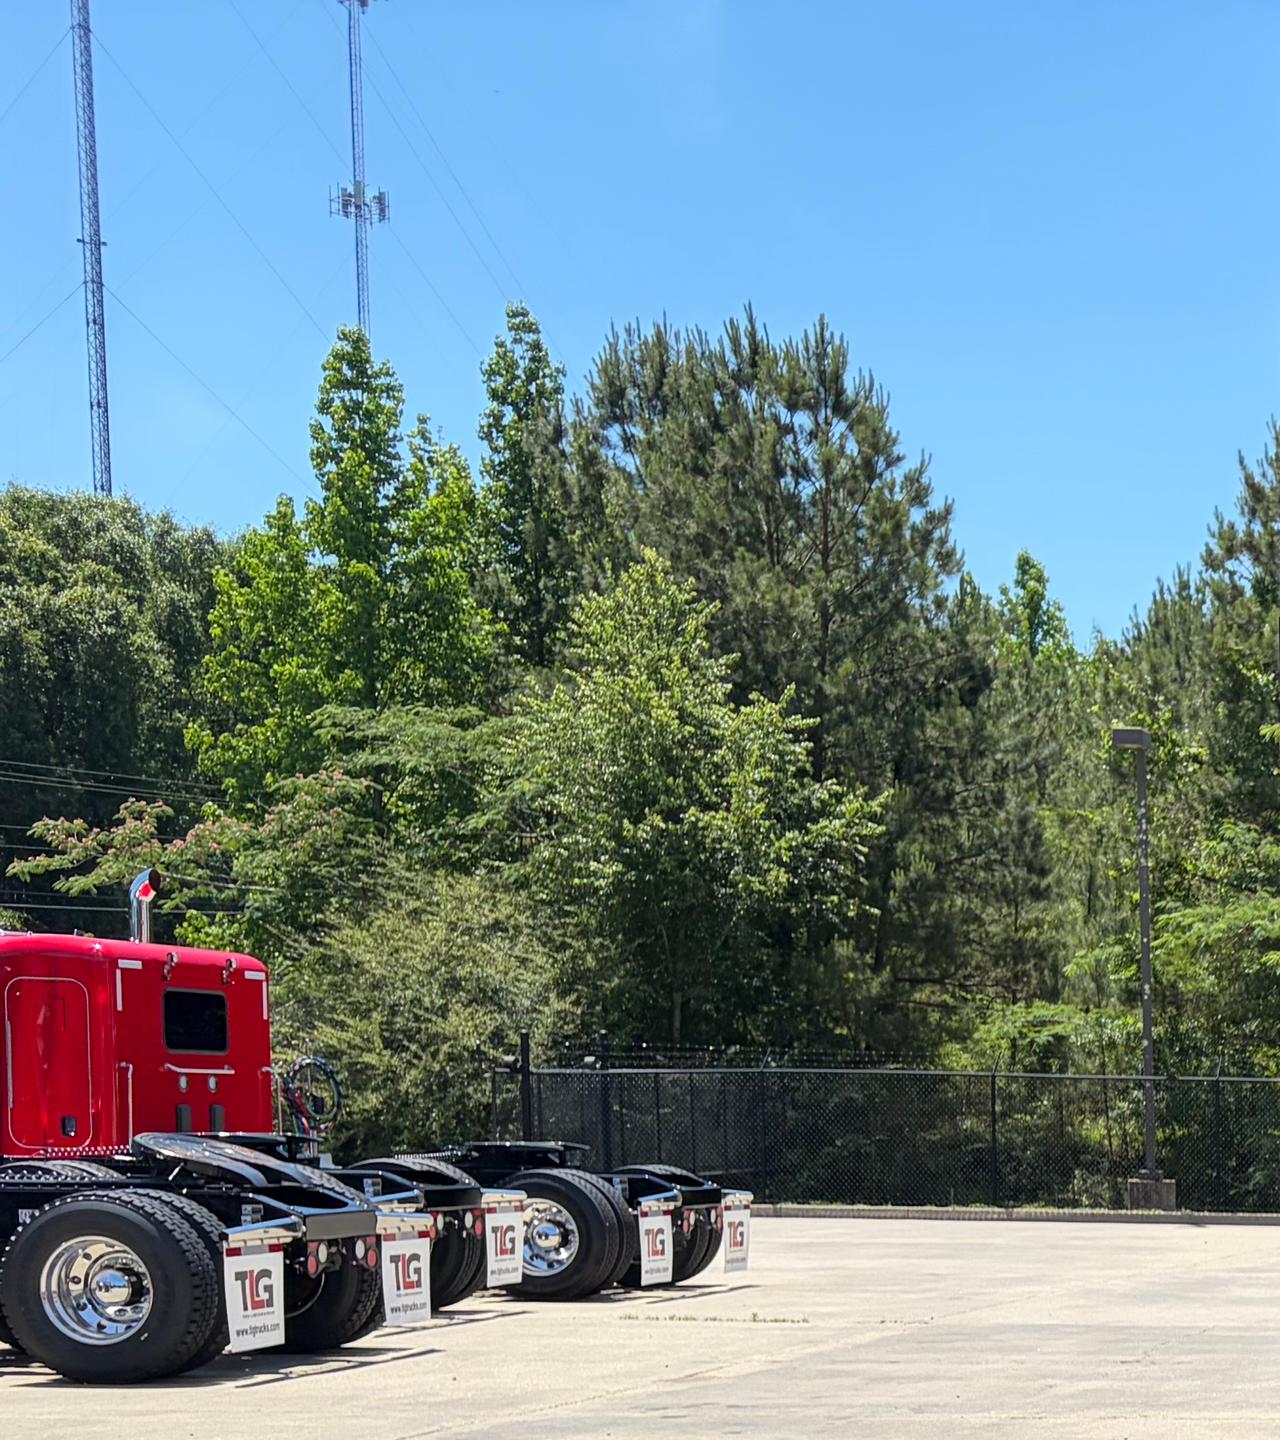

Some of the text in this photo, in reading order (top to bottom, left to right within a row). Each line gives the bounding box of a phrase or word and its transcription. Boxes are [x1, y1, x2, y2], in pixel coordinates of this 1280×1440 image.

[491, 1225, 515, 1257] TLG
[645, 1226, 665, 1258] TLG
[390, 1253, 422, 1291] TLG
[235, 1268, 273, 1312] TLG
